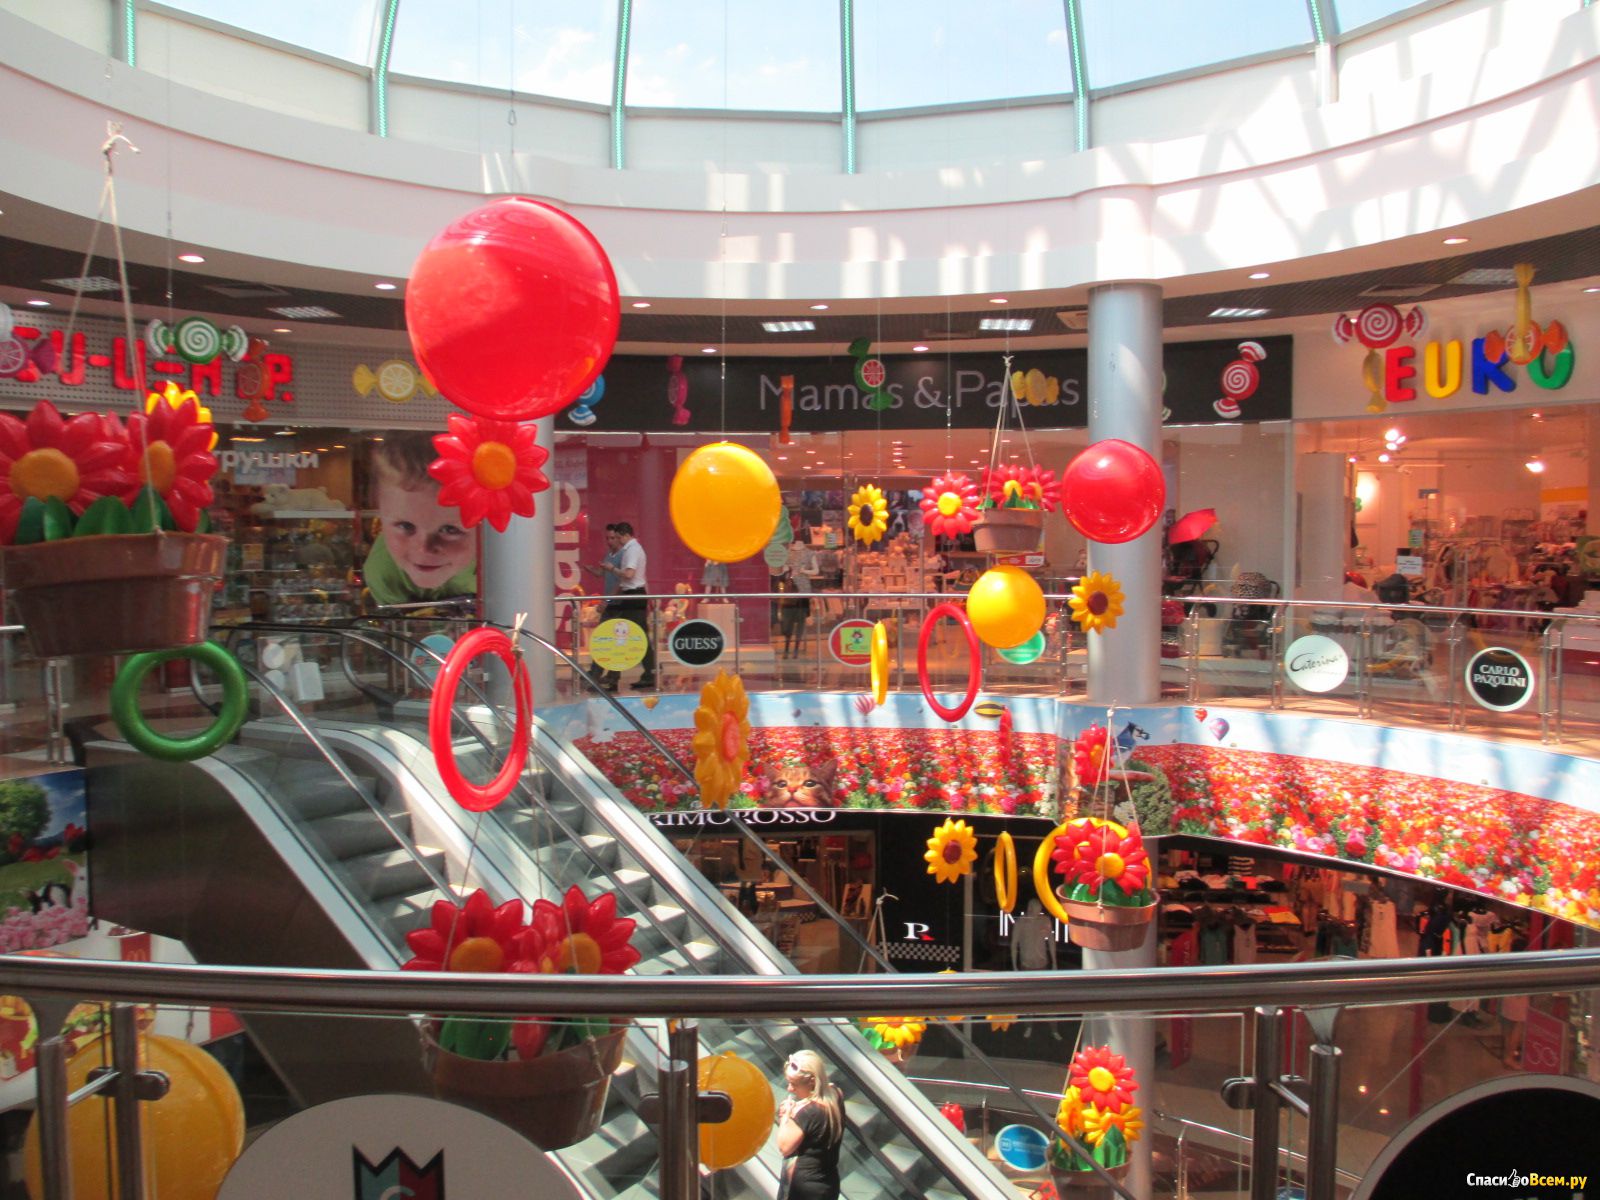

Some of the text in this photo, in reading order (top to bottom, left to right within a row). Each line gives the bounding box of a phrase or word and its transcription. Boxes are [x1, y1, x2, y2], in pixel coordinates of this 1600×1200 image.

[914, 376, 948, 409] &
[955, 370, 1079, 418] Pas
[674, 637, 718, 650] GUESS
[1480, 664, 1520, 677] CARLO
[1473, 673, 1526, 688] PAZOLINI
